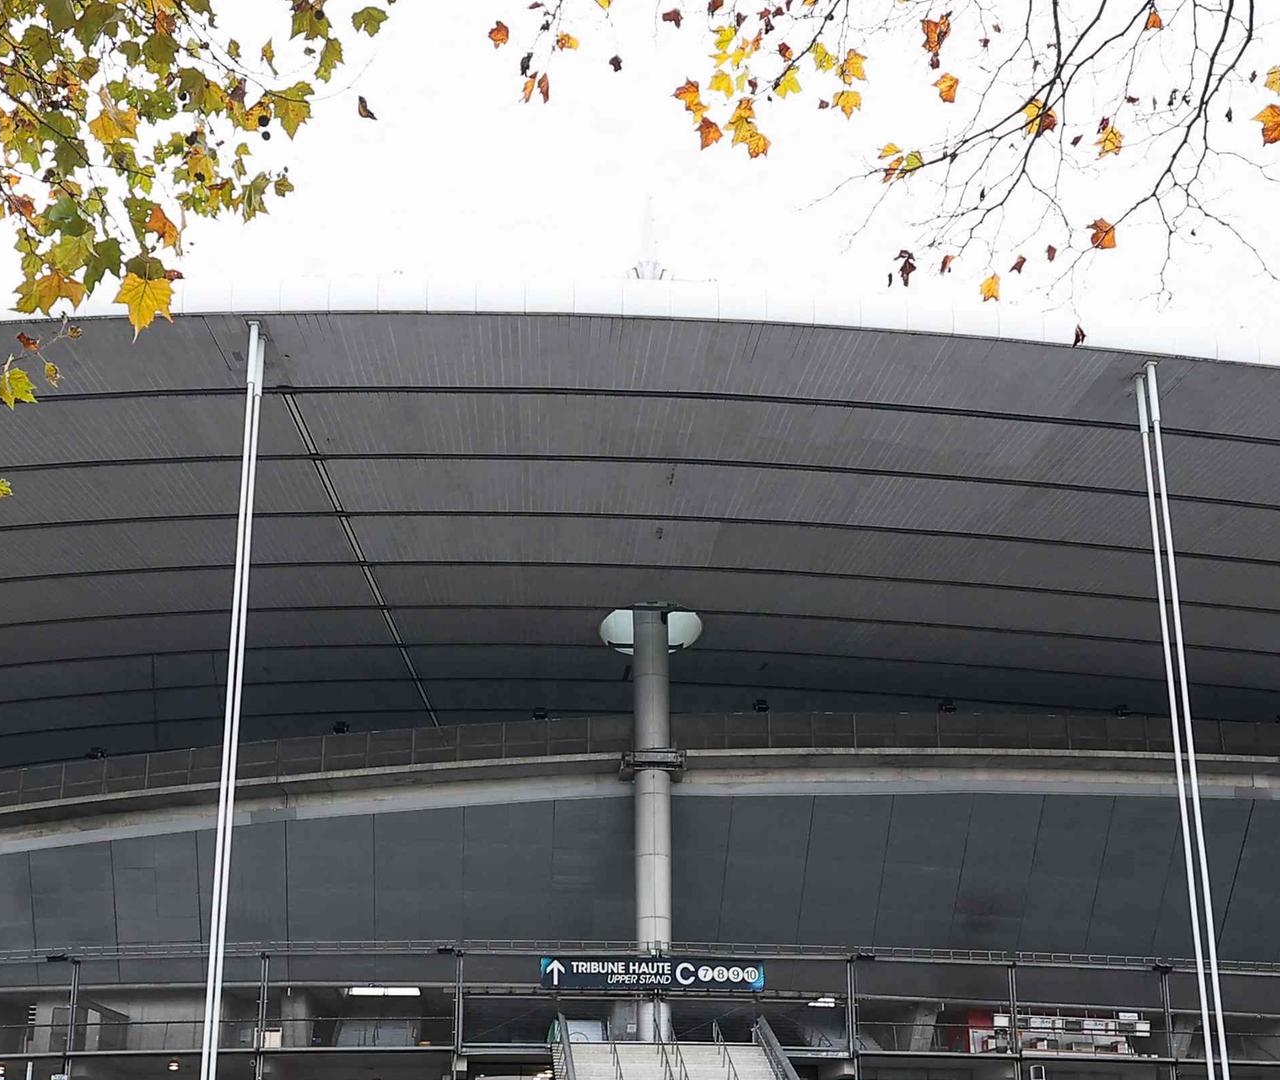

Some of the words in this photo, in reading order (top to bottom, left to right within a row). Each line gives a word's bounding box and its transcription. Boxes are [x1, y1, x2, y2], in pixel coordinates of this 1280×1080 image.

[571, 961, 626, 973] TRIBUNE
[630, 962, 671, 974] HAUTE
[676, 962, 695, 985] C
[607, 974, 637, 984] UPPER
[638, 974, 671, 984] STAND
